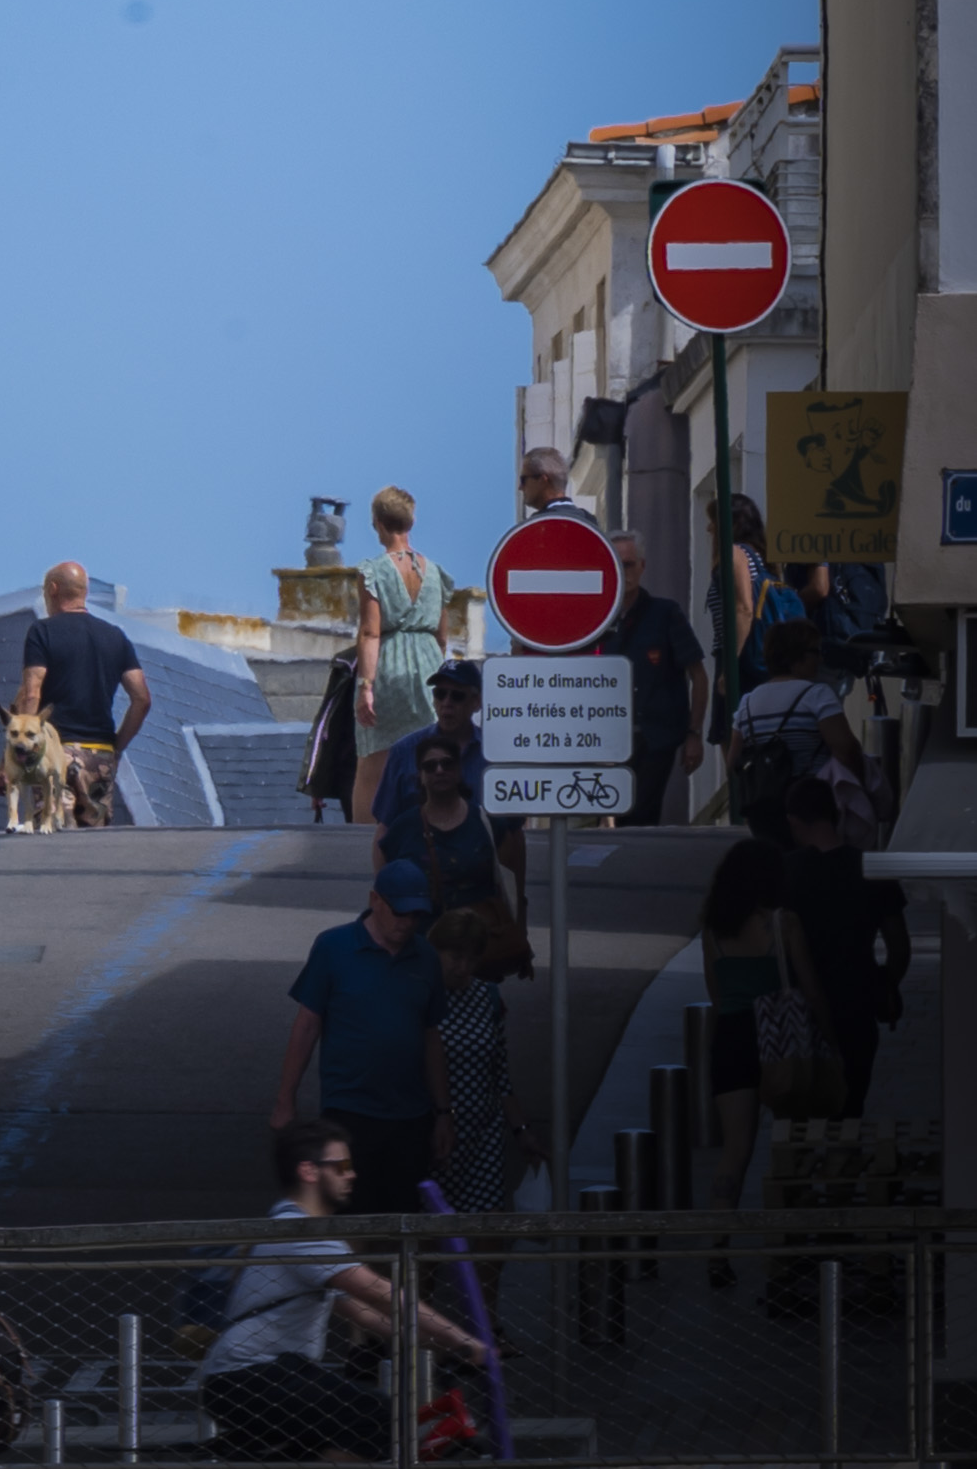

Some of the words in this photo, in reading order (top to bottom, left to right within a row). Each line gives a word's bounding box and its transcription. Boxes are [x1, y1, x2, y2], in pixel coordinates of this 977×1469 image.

[955, 495, 972, 512] du
[775, 527, 845, 558] Croqu'
[497, 674, 529, 688] Sauf
[533, 674, 544, 688] le
[548, 674, 618, 688] dimanche
[486, 703, 523, 721] jours
[527, 703, 566, 718] fériés
[570, 704, 584, 718] et
[588, 704, 628, 721] ponts
[513, 733, 530, 748] de
[535, 733, 560, 748] 12h
[564, 733, 572, 748] à
[576, 733, 602, 748] 20h
[494, 780, 553, 802] SAUF
